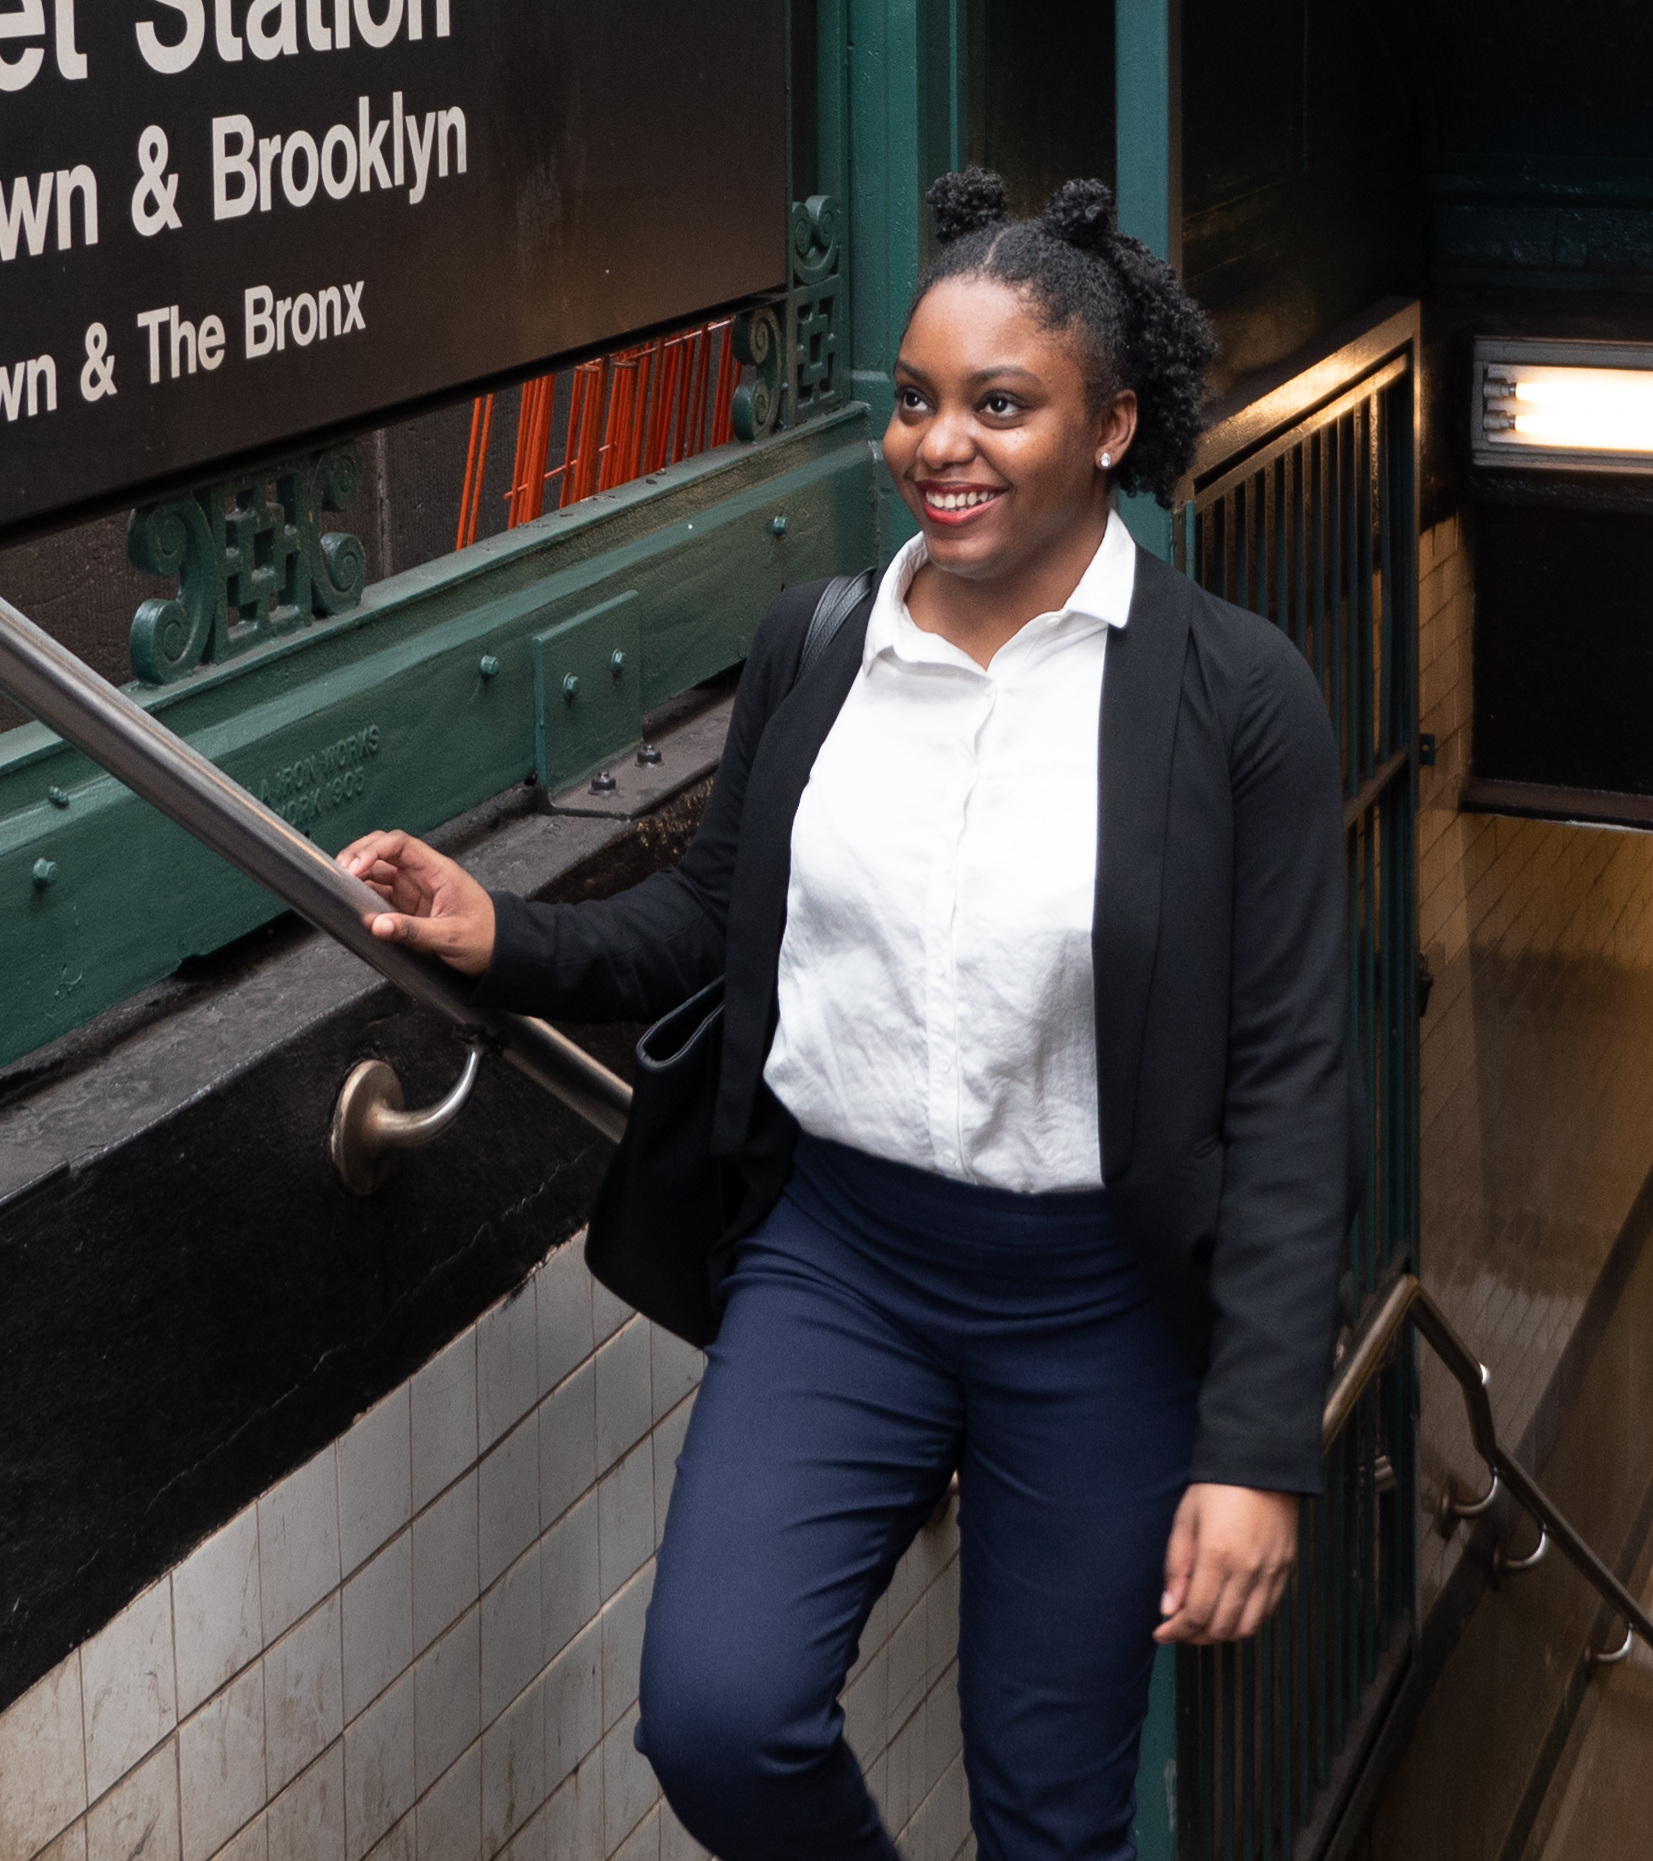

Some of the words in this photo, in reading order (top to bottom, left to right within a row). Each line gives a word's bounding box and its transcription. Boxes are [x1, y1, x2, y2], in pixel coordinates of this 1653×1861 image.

[132, 125, 182, 236] &
[213, 91, 467, 220] Brooklyn
[81, 323, 117, 401] &
[138, 305, 225, 383] The
[245, 281, 365, 358] Bronx
